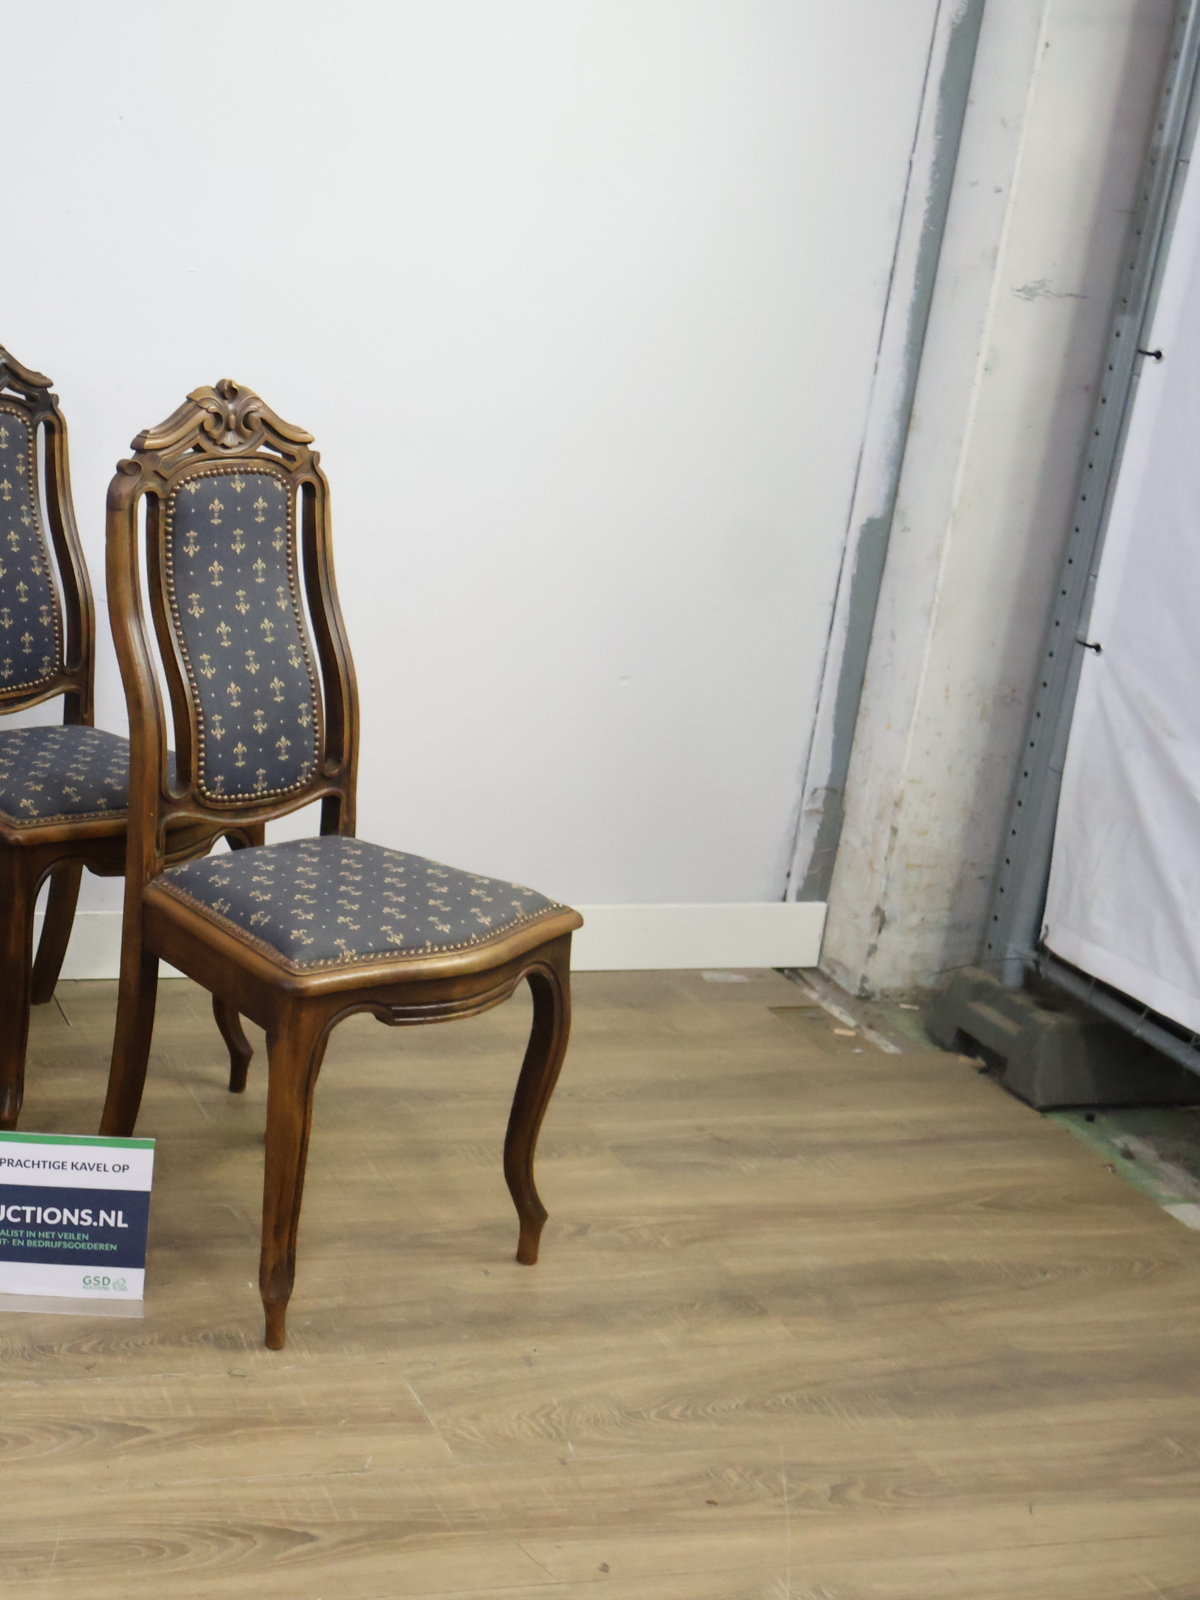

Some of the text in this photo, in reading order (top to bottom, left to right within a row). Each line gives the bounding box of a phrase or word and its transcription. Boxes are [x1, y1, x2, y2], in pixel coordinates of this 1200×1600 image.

[0, 1157, 68, 1170] PRACHTIGE
[71, 1161, 109, 1172] KAVEL
[112, 1164, 130, 1173] OP
[26, 1230, 36, 1239] IN
[38, 1231, 56, 1240] HET
[57, 1232, 89, 1241] VEILEN
[12, 1239, 24, 1247] EN
[26, 1239, 118, 1251] BEDRIJFSGOEDEREN
[82, 1275, 111, 1286] GSD
